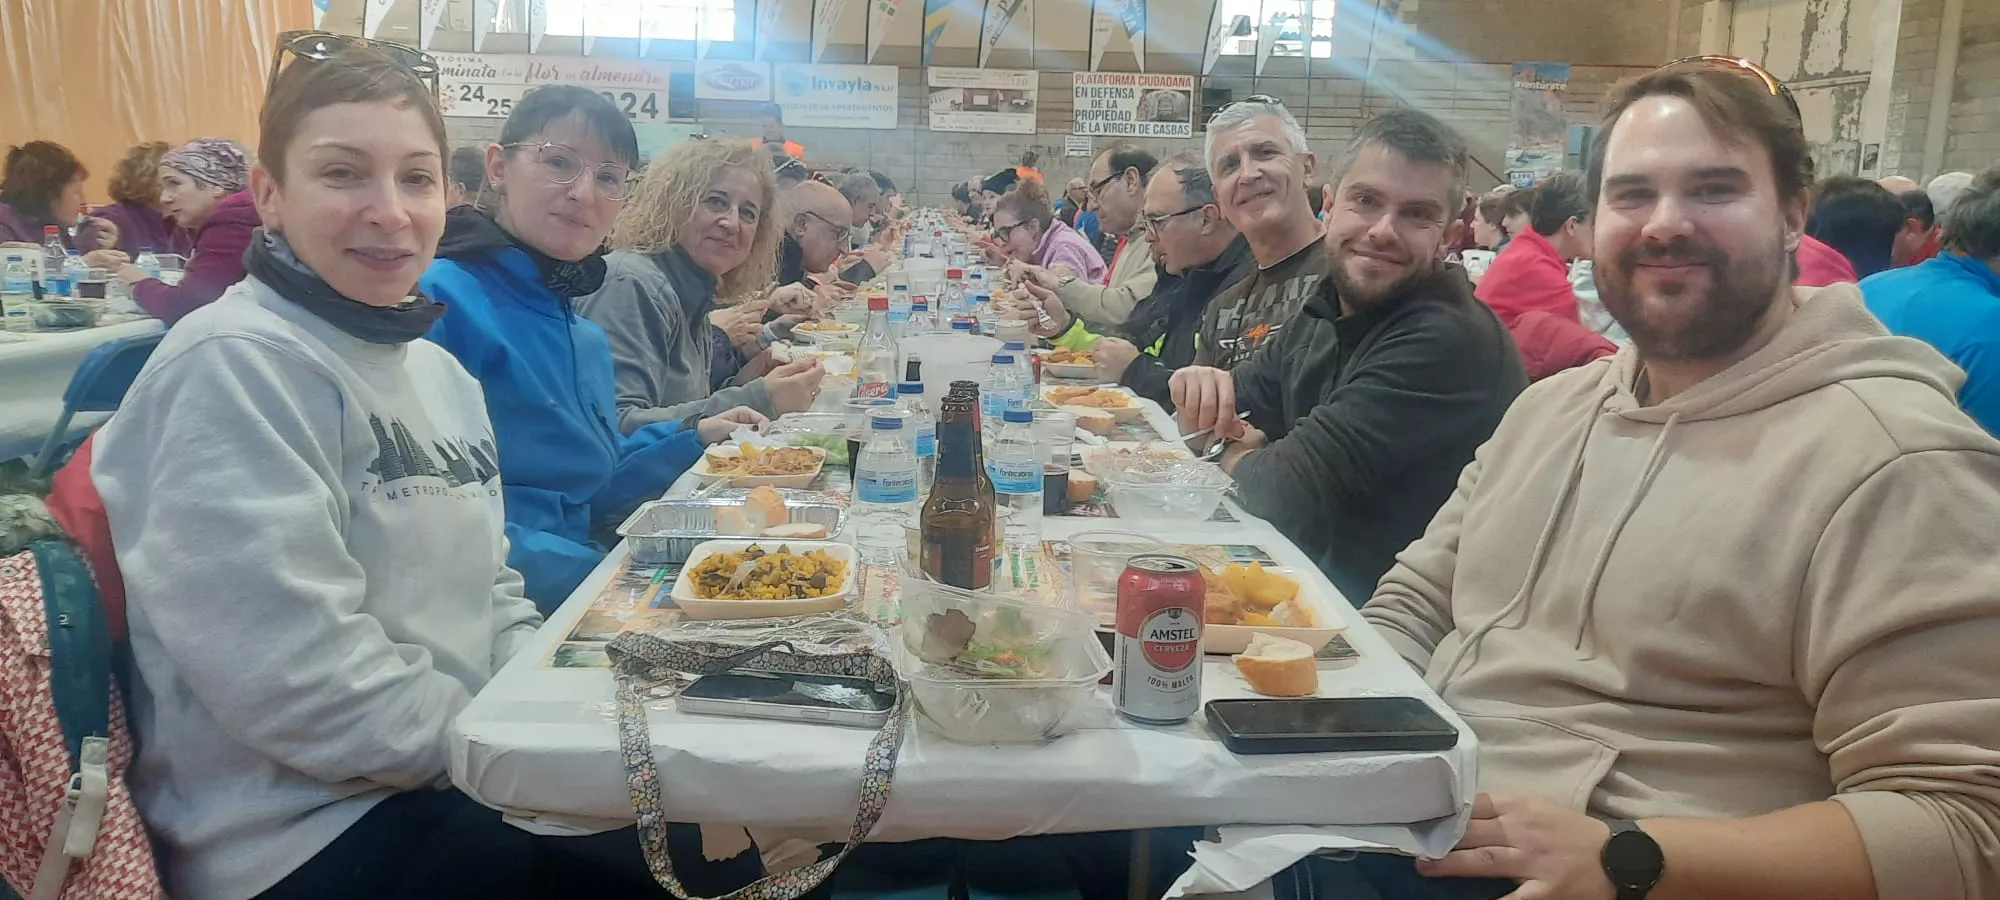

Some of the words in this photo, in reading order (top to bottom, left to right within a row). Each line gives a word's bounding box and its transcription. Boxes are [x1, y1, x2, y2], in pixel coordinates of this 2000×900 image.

[439, 64, 497, 78] minata
[812, 76, 872, 93] Invayla
[1075, 74, 1136, 86] PLATAFORMA
[1138, 75, 1192, 88] CIUDADANA
[459, 85, 485, 102] 24
[1075, 86, 1088, 98] EN
[1091, 87, 1135, 99] DEFENSA
[487, 98, 512, 116] 25
[1091, 99, 1102, 109] DE
[1106, 99, 1118, 109] LA
[1075, 109, 1132, 121] PROPIEDAD
[1074, 122, 1087, 133] DE
[1088, 122, 1101, 133] LA
[1103, 122, 1136, 134] VIRGEN
[1138, 123, 1151, 135] DE
[1153, 123, 1190, 136] CASBAS
[1150, 628, 1195, 641] AMSTEL
[1153, 644, 1190, 653] CERVEZA
[1171, 674, 1194, 689] MALTA
